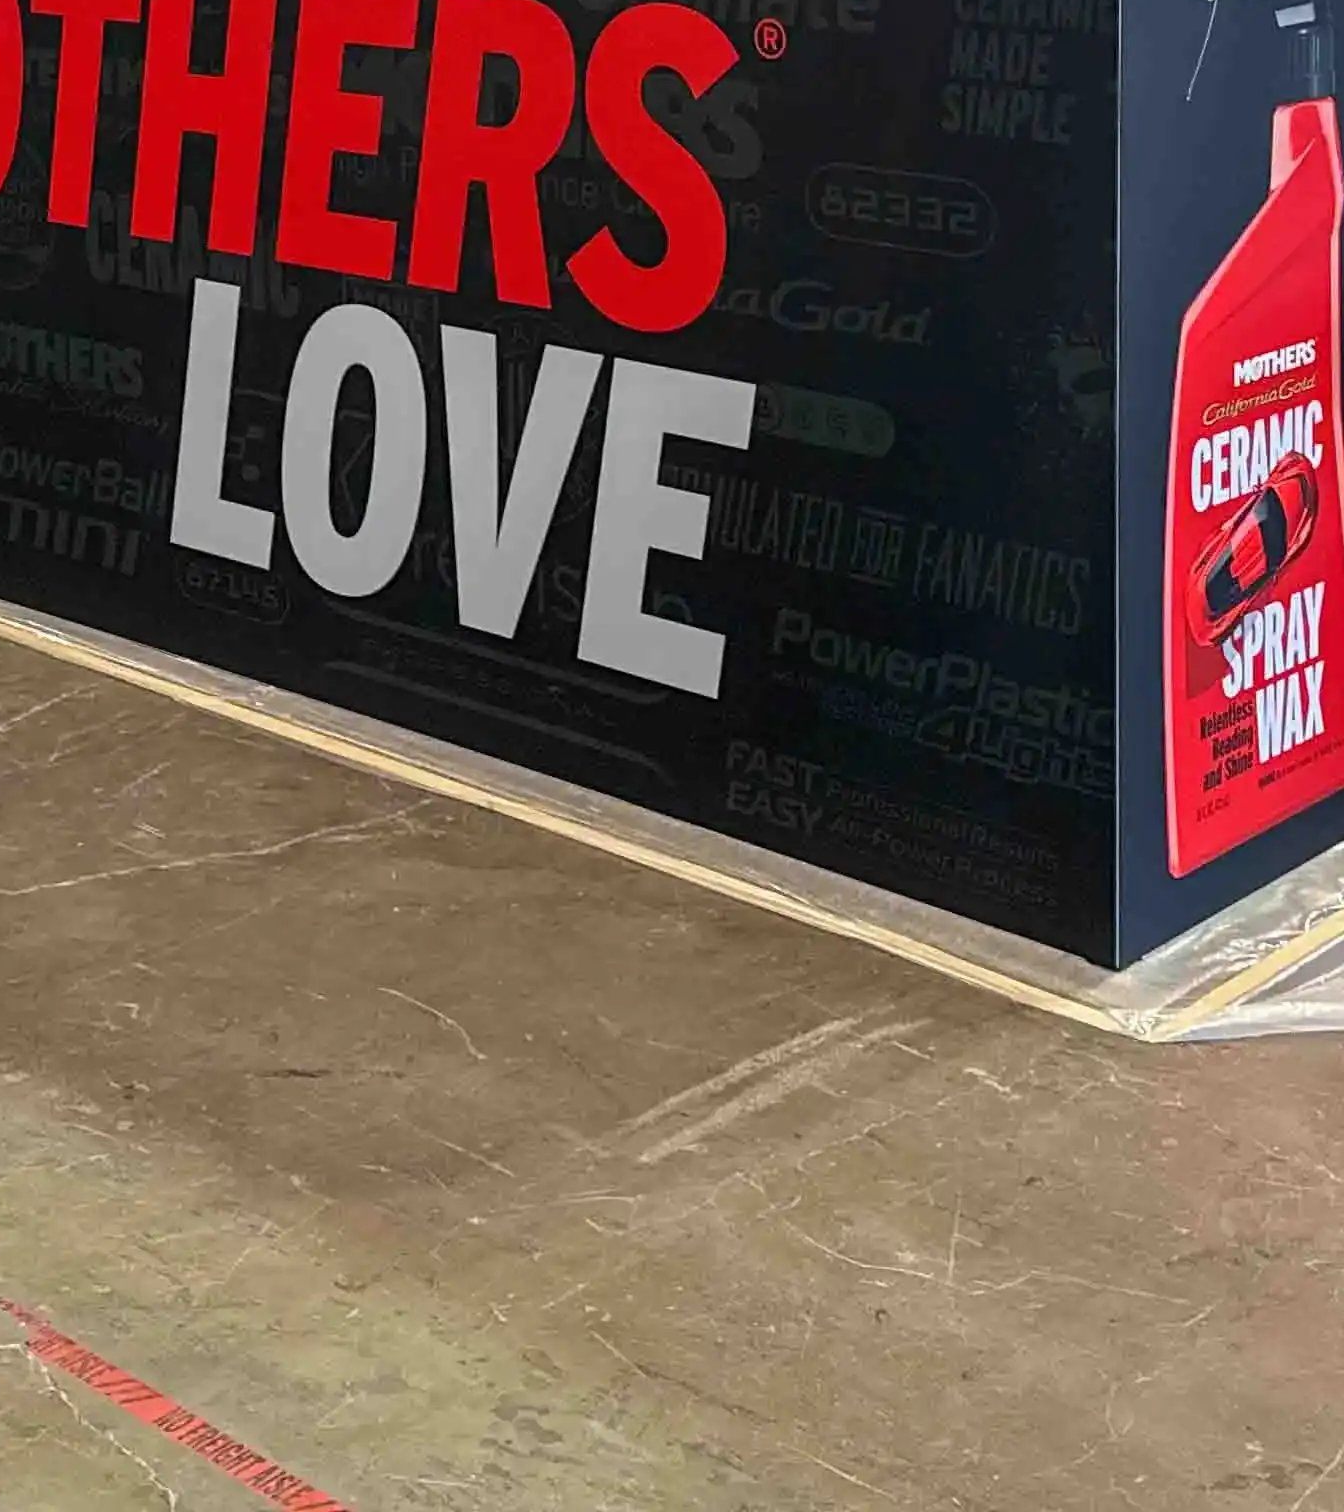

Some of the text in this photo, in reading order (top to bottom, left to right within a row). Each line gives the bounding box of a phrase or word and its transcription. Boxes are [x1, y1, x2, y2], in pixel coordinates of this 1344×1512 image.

[949, 29, 1054, 86] MADE
[939, 83, 1078, 146] SIMPLE
[819, 185, 979, 236] 82332
[1232, 337, 1318, 388] MOTHERS
[1202, 375, 1317, 426] California Gold
[1190, 399, 1324, 513] CERAMIC
[168, 275, 759, 701] LOVE
[912, 521, 1091, 637] FANATICS
[1222, 580, 1326, 700] SPRAY
[1199, 699, 1254, 740] Relentless
[1255, 659, 1325, 765] WAX
[724, 738, 824, 794] FAST
[1202, 764, 1224, 793] and
[1224, 750, 1254, 782] Shine
[724, 778, 825, 837] EASY
[155, 1405, 316, 1508] NO FREIGHT AISLE
